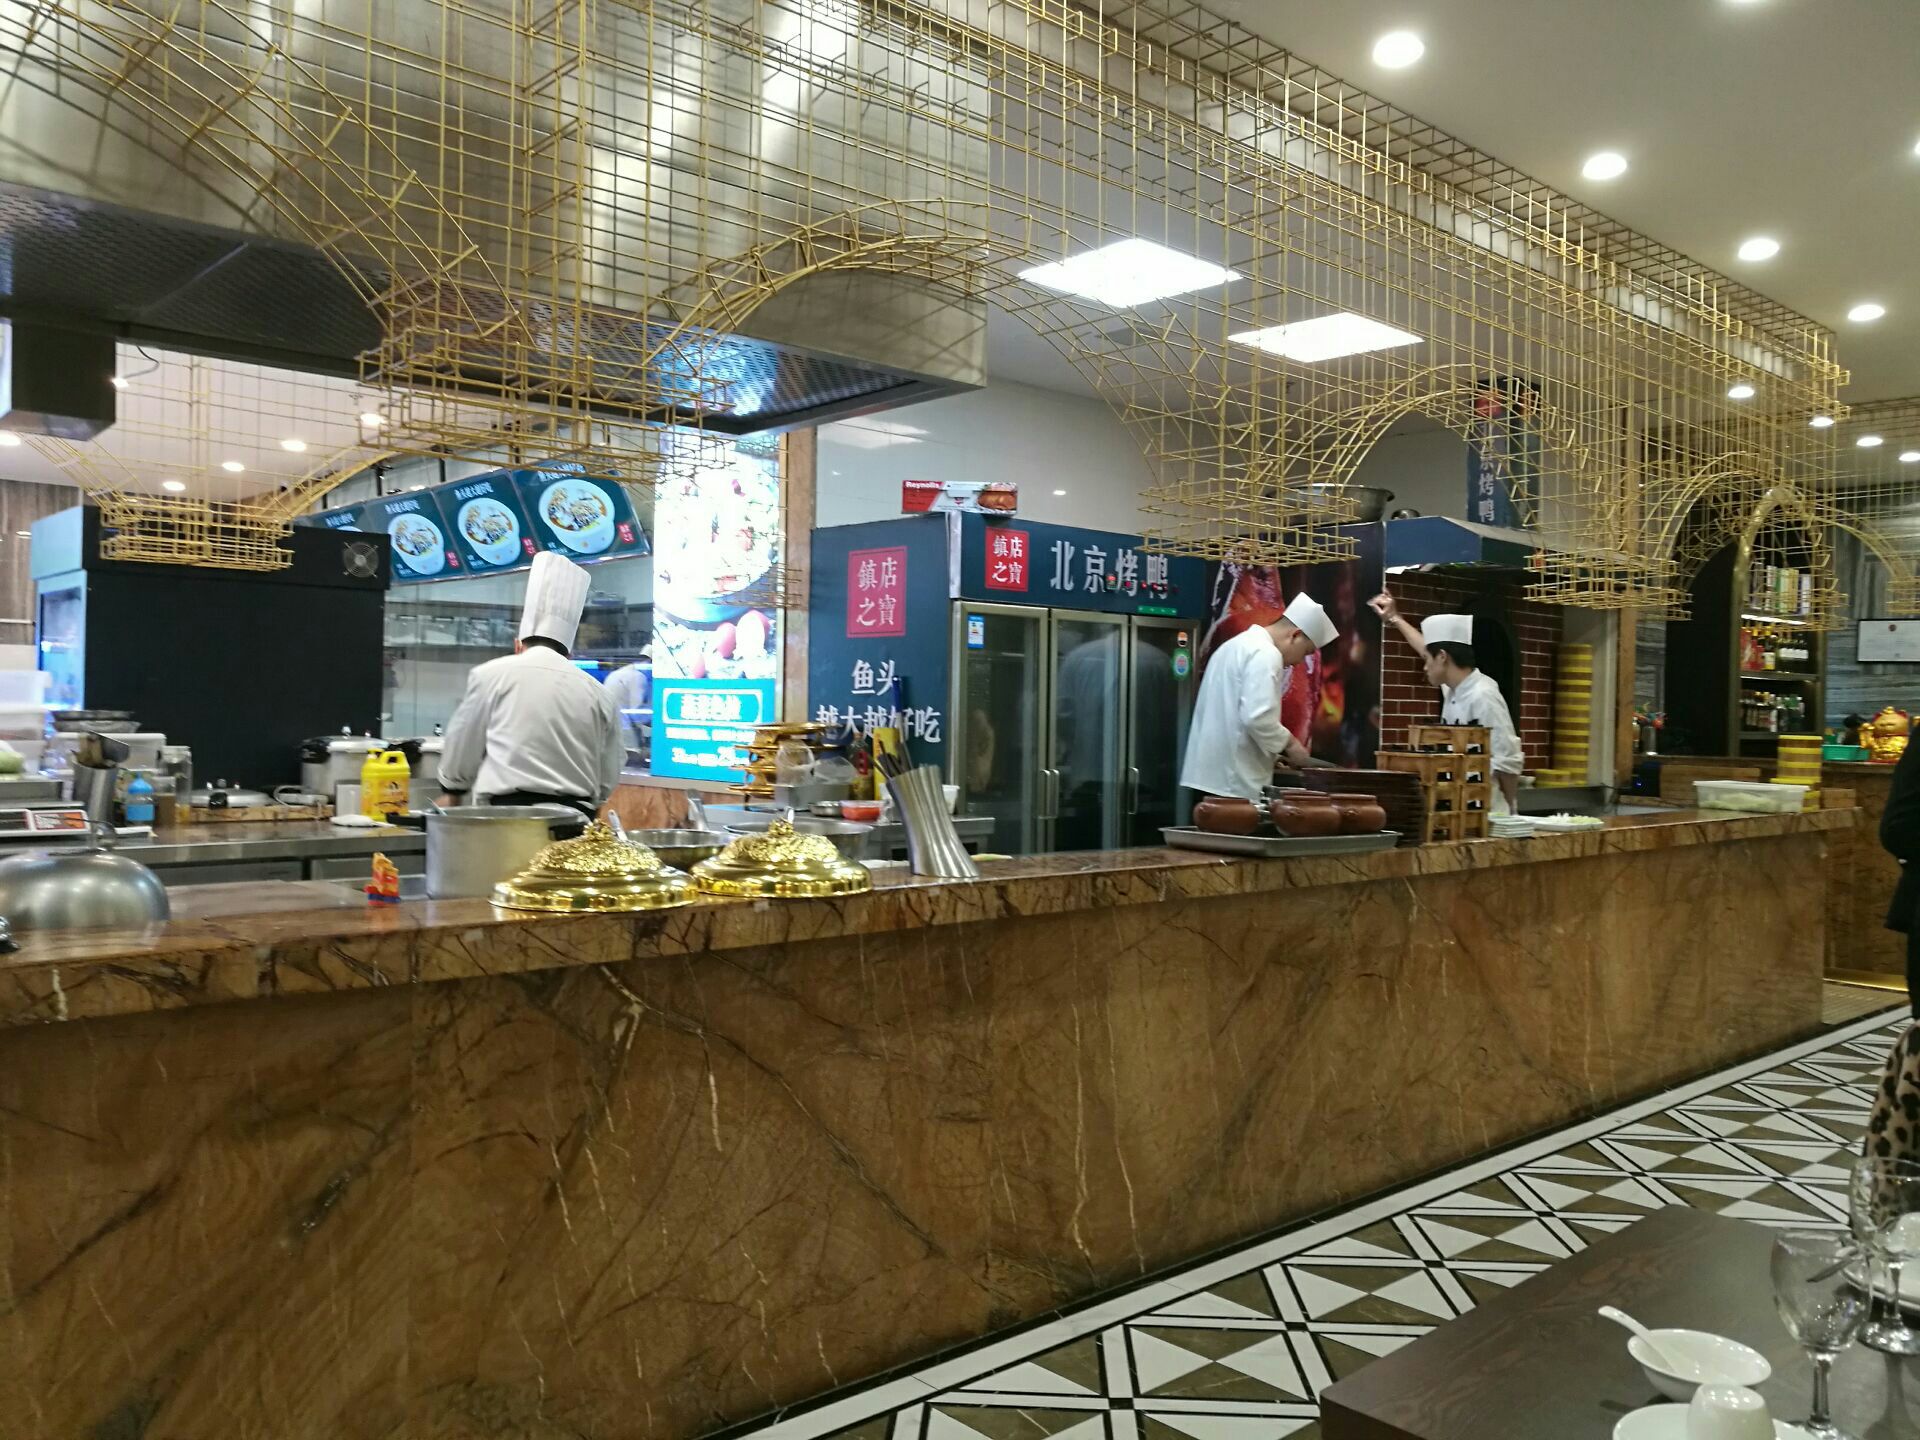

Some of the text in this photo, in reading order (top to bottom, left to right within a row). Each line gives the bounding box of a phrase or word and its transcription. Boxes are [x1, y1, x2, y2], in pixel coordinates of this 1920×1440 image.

[1050, 540, 1168, 600] 北京烤鸭
[851, 658, 900, 696] 鱼头
